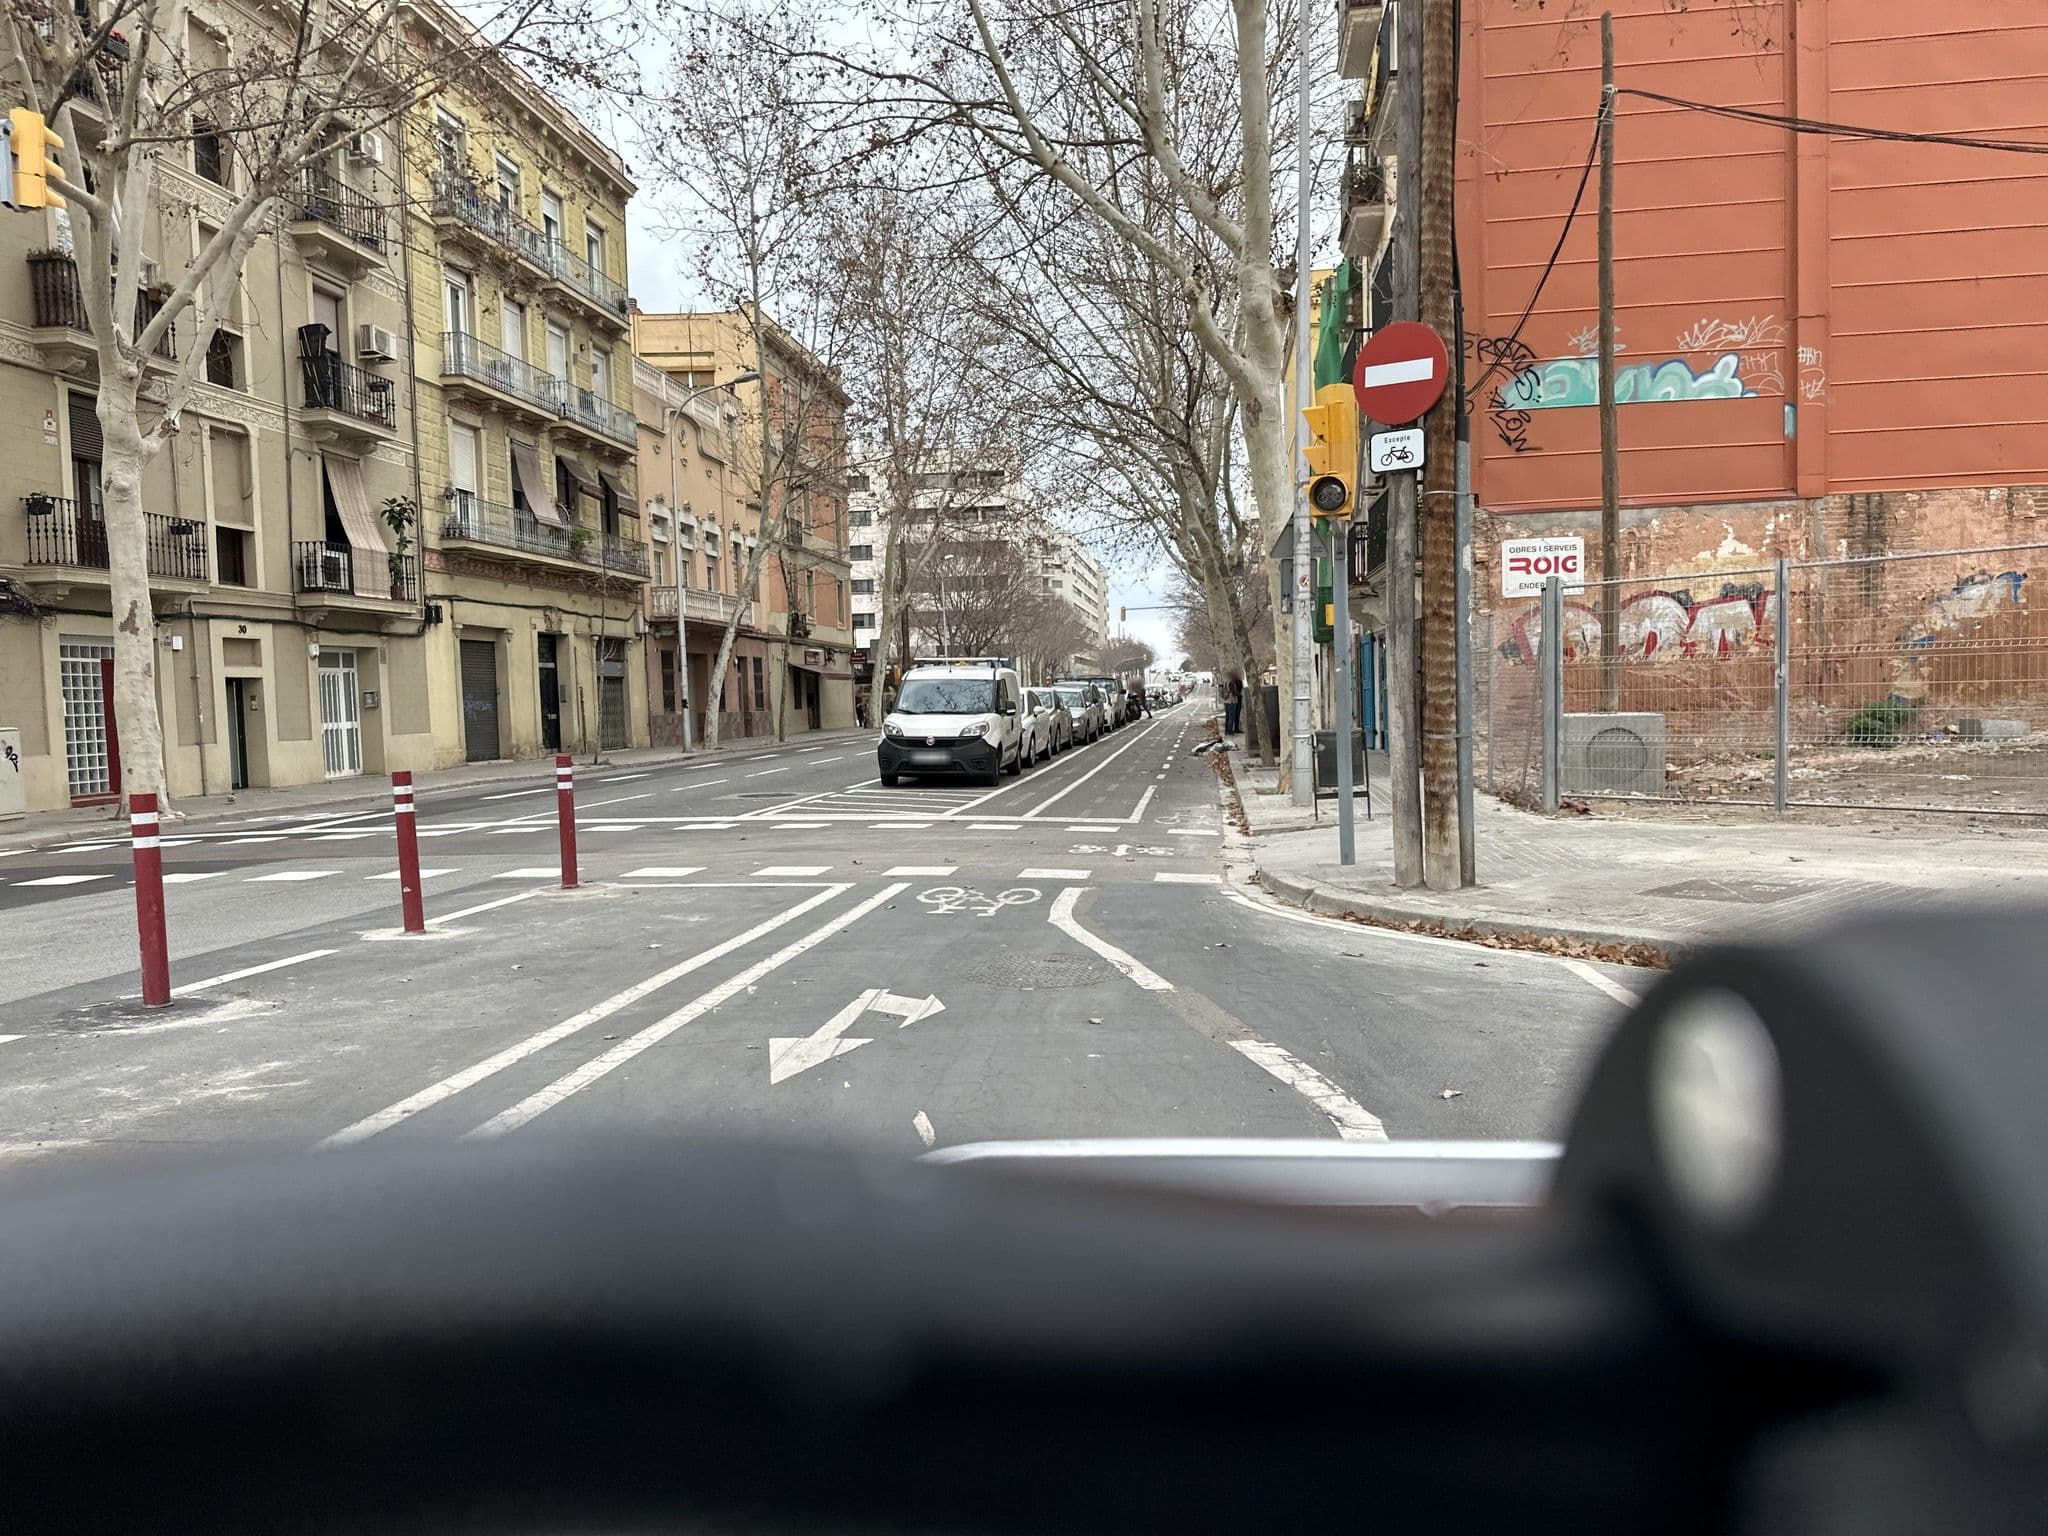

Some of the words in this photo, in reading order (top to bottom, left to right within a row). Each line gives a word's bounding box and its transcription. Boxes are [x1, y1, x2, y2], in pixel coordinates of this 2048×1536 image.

[1384, 435, 1411, 443] Excepte
[1543, 544, 1577, 552] SERVEIS
[1509, 555, 1577, 575] ROIG
[238, 624, 247, 634] 30
